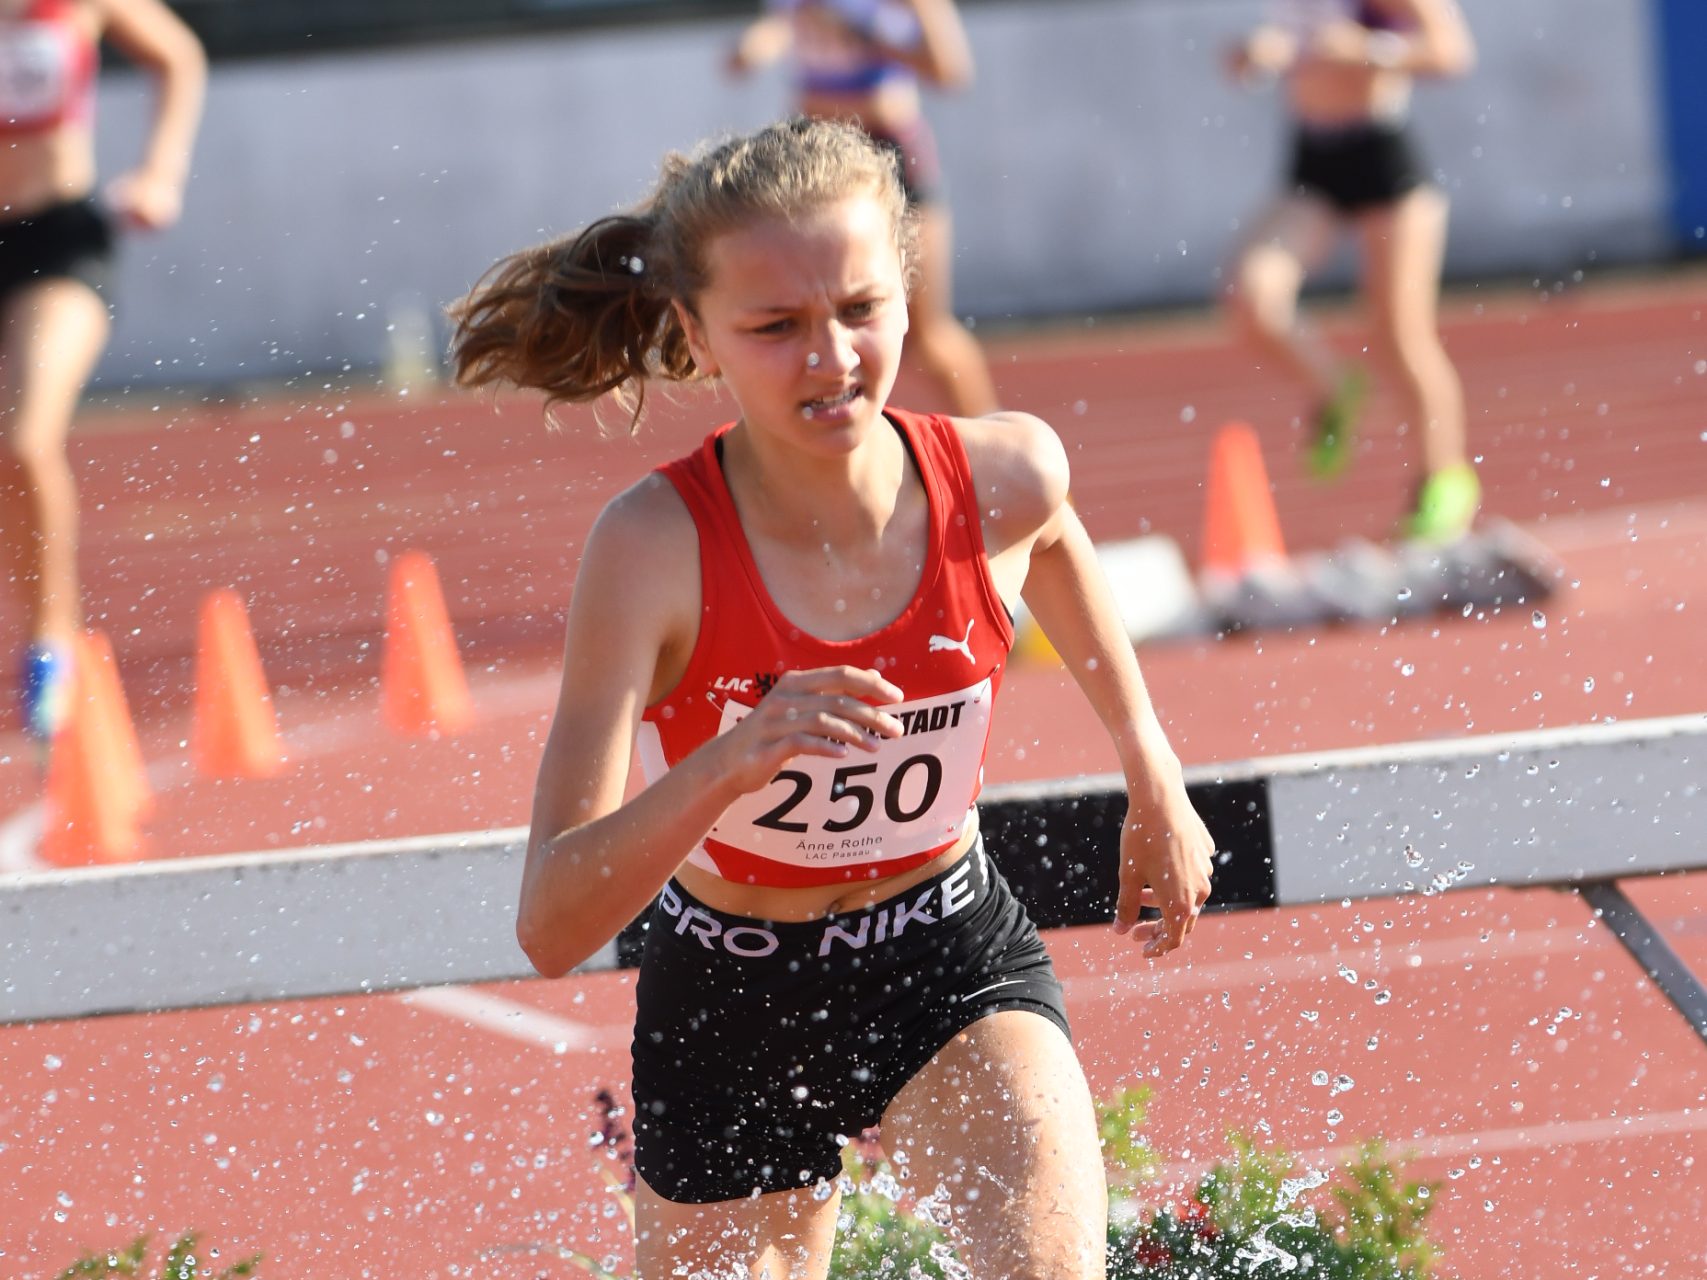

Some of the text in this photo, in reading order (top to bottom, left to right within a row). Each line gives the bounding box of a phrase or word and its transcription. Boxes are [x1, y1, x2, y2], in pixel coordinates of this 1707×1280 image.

[714, 676, 753, 693] LAC
[752, 754, 943, 833] 250
[796, 839, 835, 851] Änne
[832, 849, 870, 859] Passau
[659, 859, 975, 957] PRO NIKE
